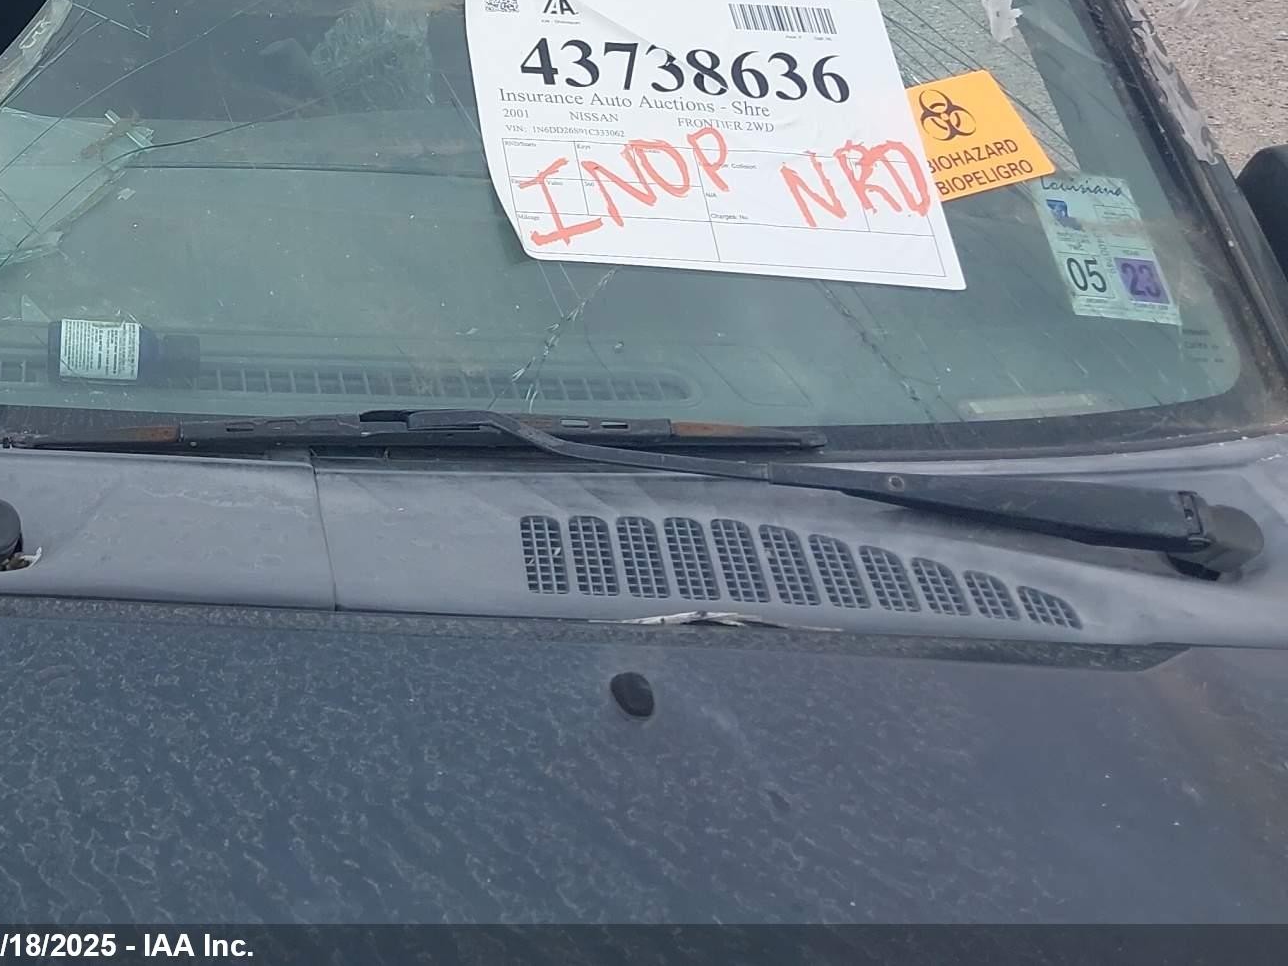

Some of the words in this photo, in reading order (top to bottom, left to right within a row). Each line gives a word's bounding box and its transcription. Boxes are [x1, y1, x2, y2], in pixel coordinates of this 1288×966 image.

[520, 37, 850, 104] 43738636
[499, 88, 584, 105] Insurance
[590, 92, 632, 108] Auto
[639, 95, 715, 113] Auctions
[731, 100, 771, 117] Shre
[503, 108, 529, 118] 2001
[569, 111, 619, 123] NISSAN
[678, 117, 743, 131] FRONTIER
[746, 121, 774, 133] 2WD
[505, 124, 527, 133] VIN:
[519, 127, 729, 247] INOP
[780, 140, 931, 227] NRD
[935, 159, 1033, 195] BIOPELIGRO
[1066, 257, 1107, 293] 05
